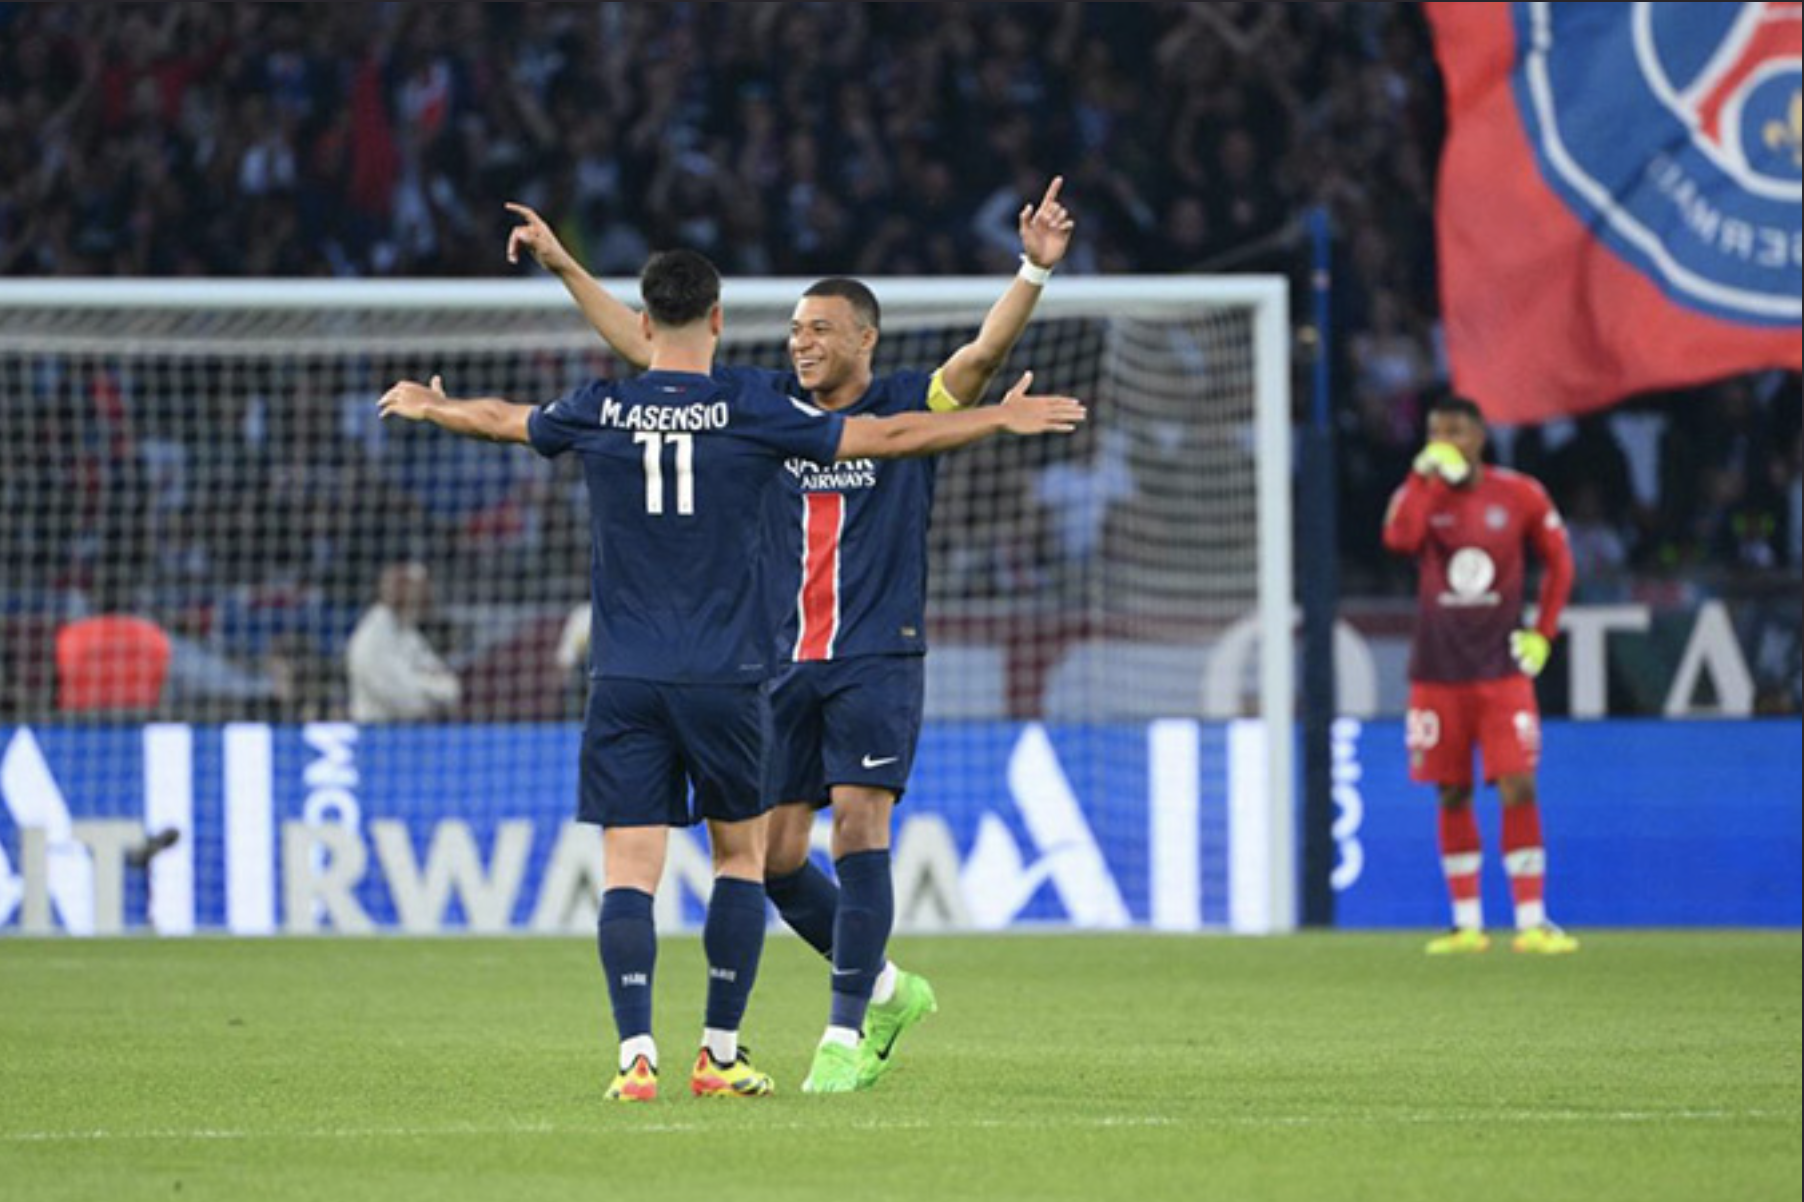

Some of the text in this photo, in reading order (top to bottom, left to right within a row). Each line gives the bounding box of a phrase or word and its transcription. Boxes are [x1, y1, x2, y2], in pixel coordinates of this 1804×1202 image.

[600, 397, 729, 431] M.ASENSIO
[633, 431, 695, 515] 11
[801, 471, 876, 490] AIRWAYS
